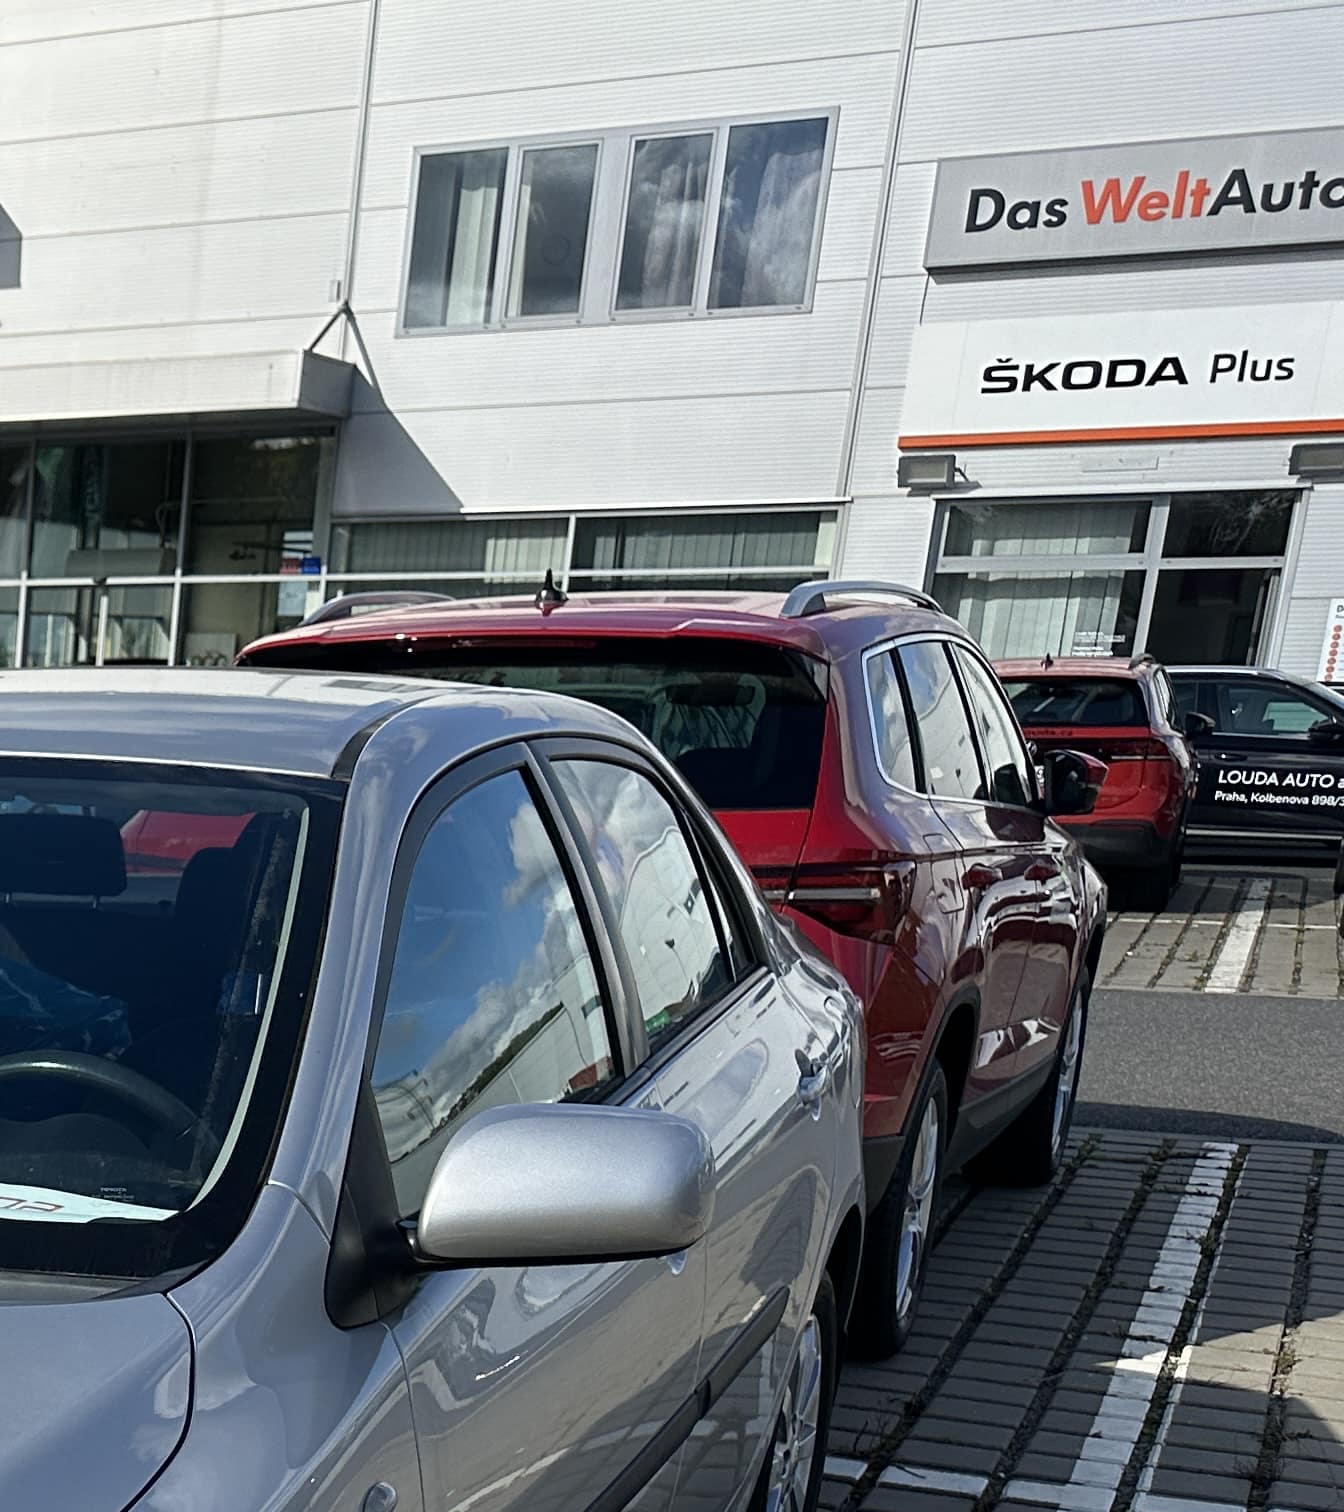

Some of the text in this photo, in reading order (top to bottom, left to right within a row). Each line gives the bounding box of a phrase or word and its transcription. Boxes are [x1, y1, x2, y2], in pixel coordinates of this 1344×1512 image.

[965, 187, 1069, 234] Das
[980, 349, 1295, 394] ŠKODA Plus
[1218, 770, 1279, 787] LOUDA
[1282, 772, 1335, 789] AUTO
[1214, 790, 1248, 804] Praha,
[1250, 791, 1309, 805] Kolbenova
